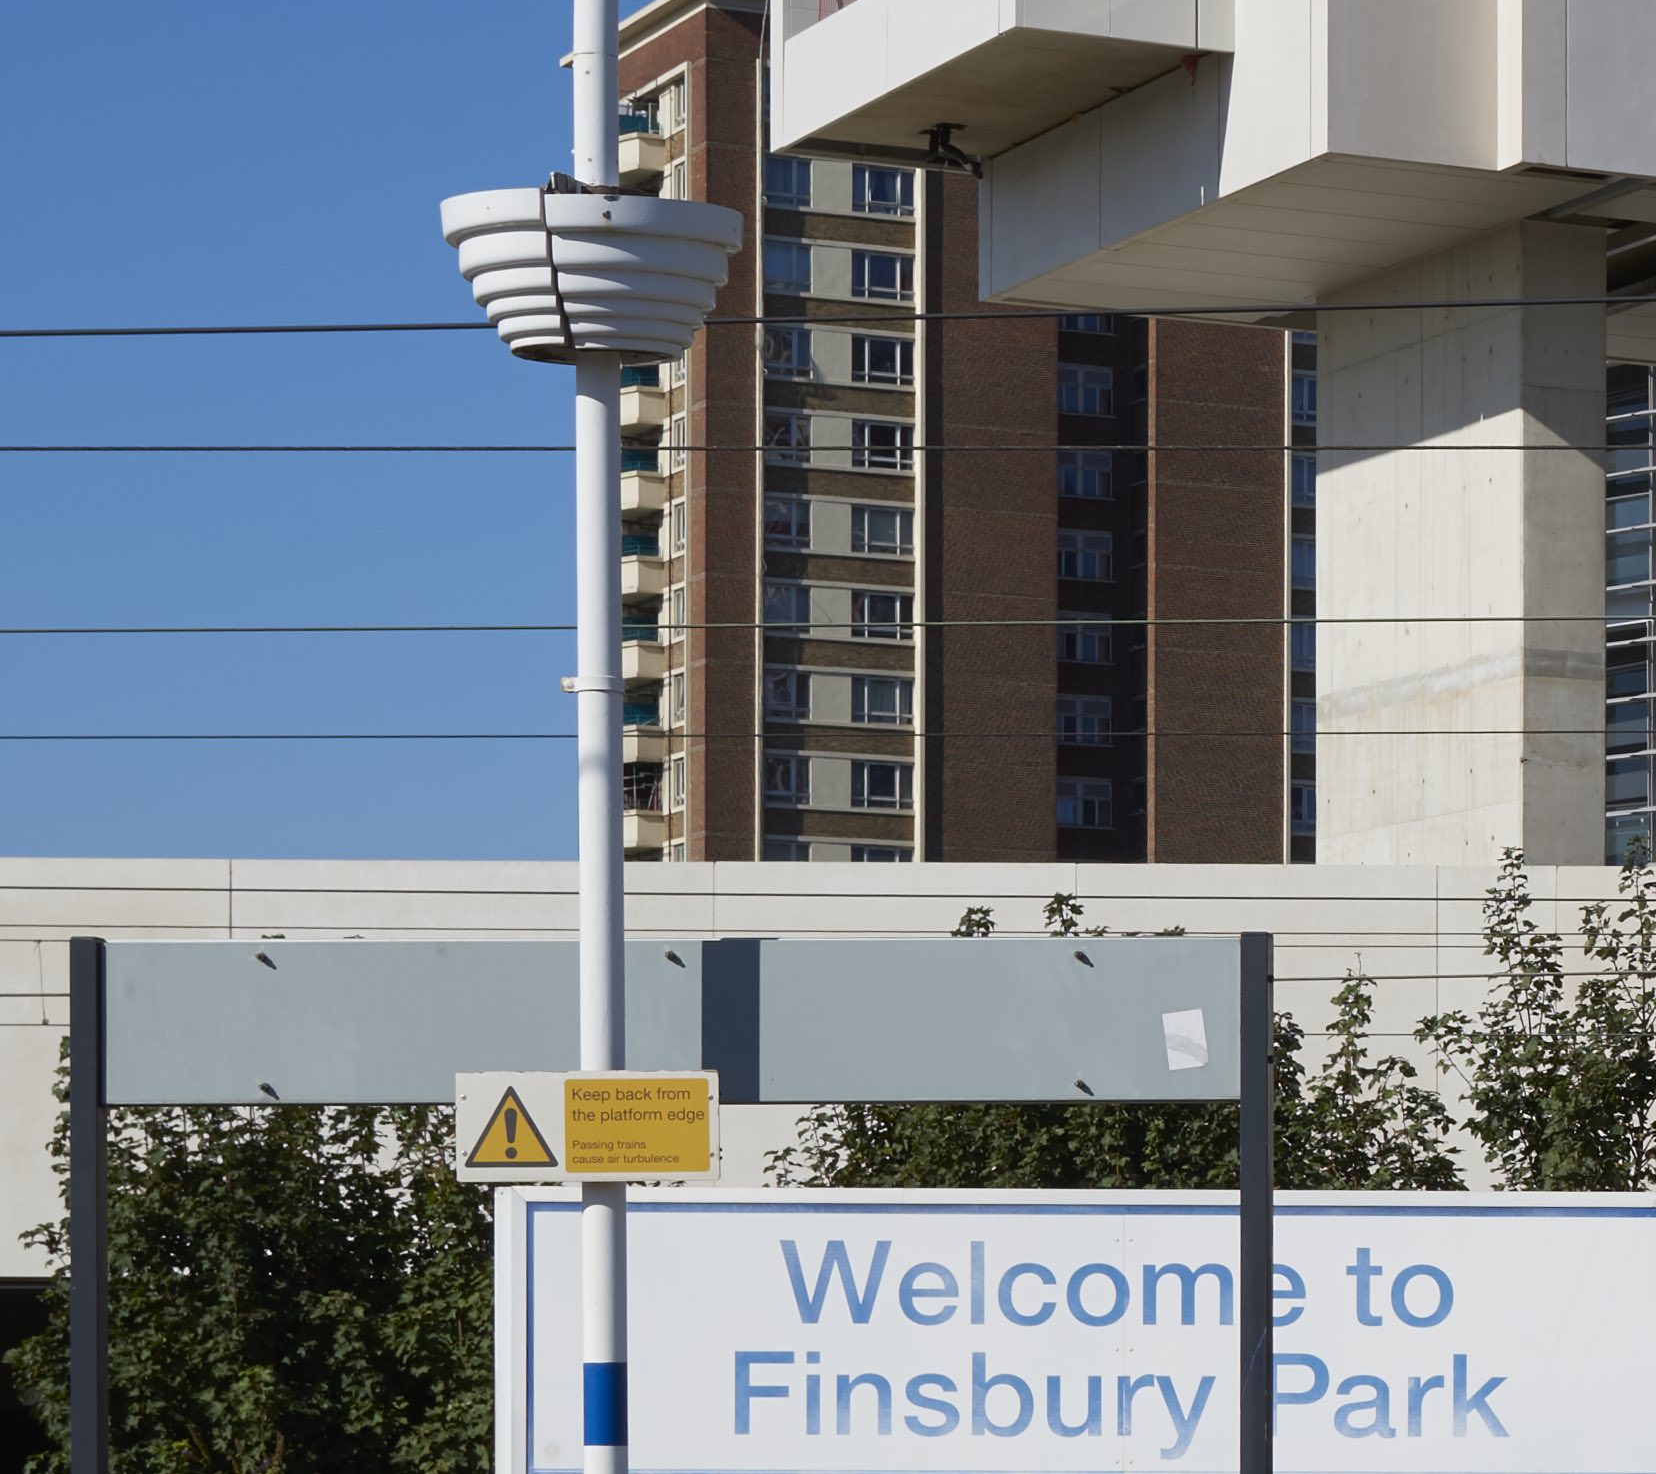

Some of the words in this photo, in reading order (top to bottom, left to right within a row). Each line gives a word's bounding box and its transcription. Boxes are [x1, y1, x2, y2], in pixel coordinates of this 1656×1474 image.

[571, 1088, 611, 1104] Keep
[615, 1087, 651, 1101] back
[656, 1087, 691, 1101] from
[571, 1108, 596, 1121] the
[600, 1107, 662, 1125] platform
[667, 1107, 705, 1125] edge
[572, 1140, 614, 1153] Passing
[617, 1140, 647, 1150] trains
[572, 1154, 605, 1164] cause
[607, 1153, 620, 1164] air
[623, 1153, 679, 1164] turbulence
[782, 1239, 1306, 1328] Welcome
[1347, 1246, 1455, 1328] to
[733, 1351, 1216, 1460] Finsbury
[1271, 1352, 1510, 1439] Park
